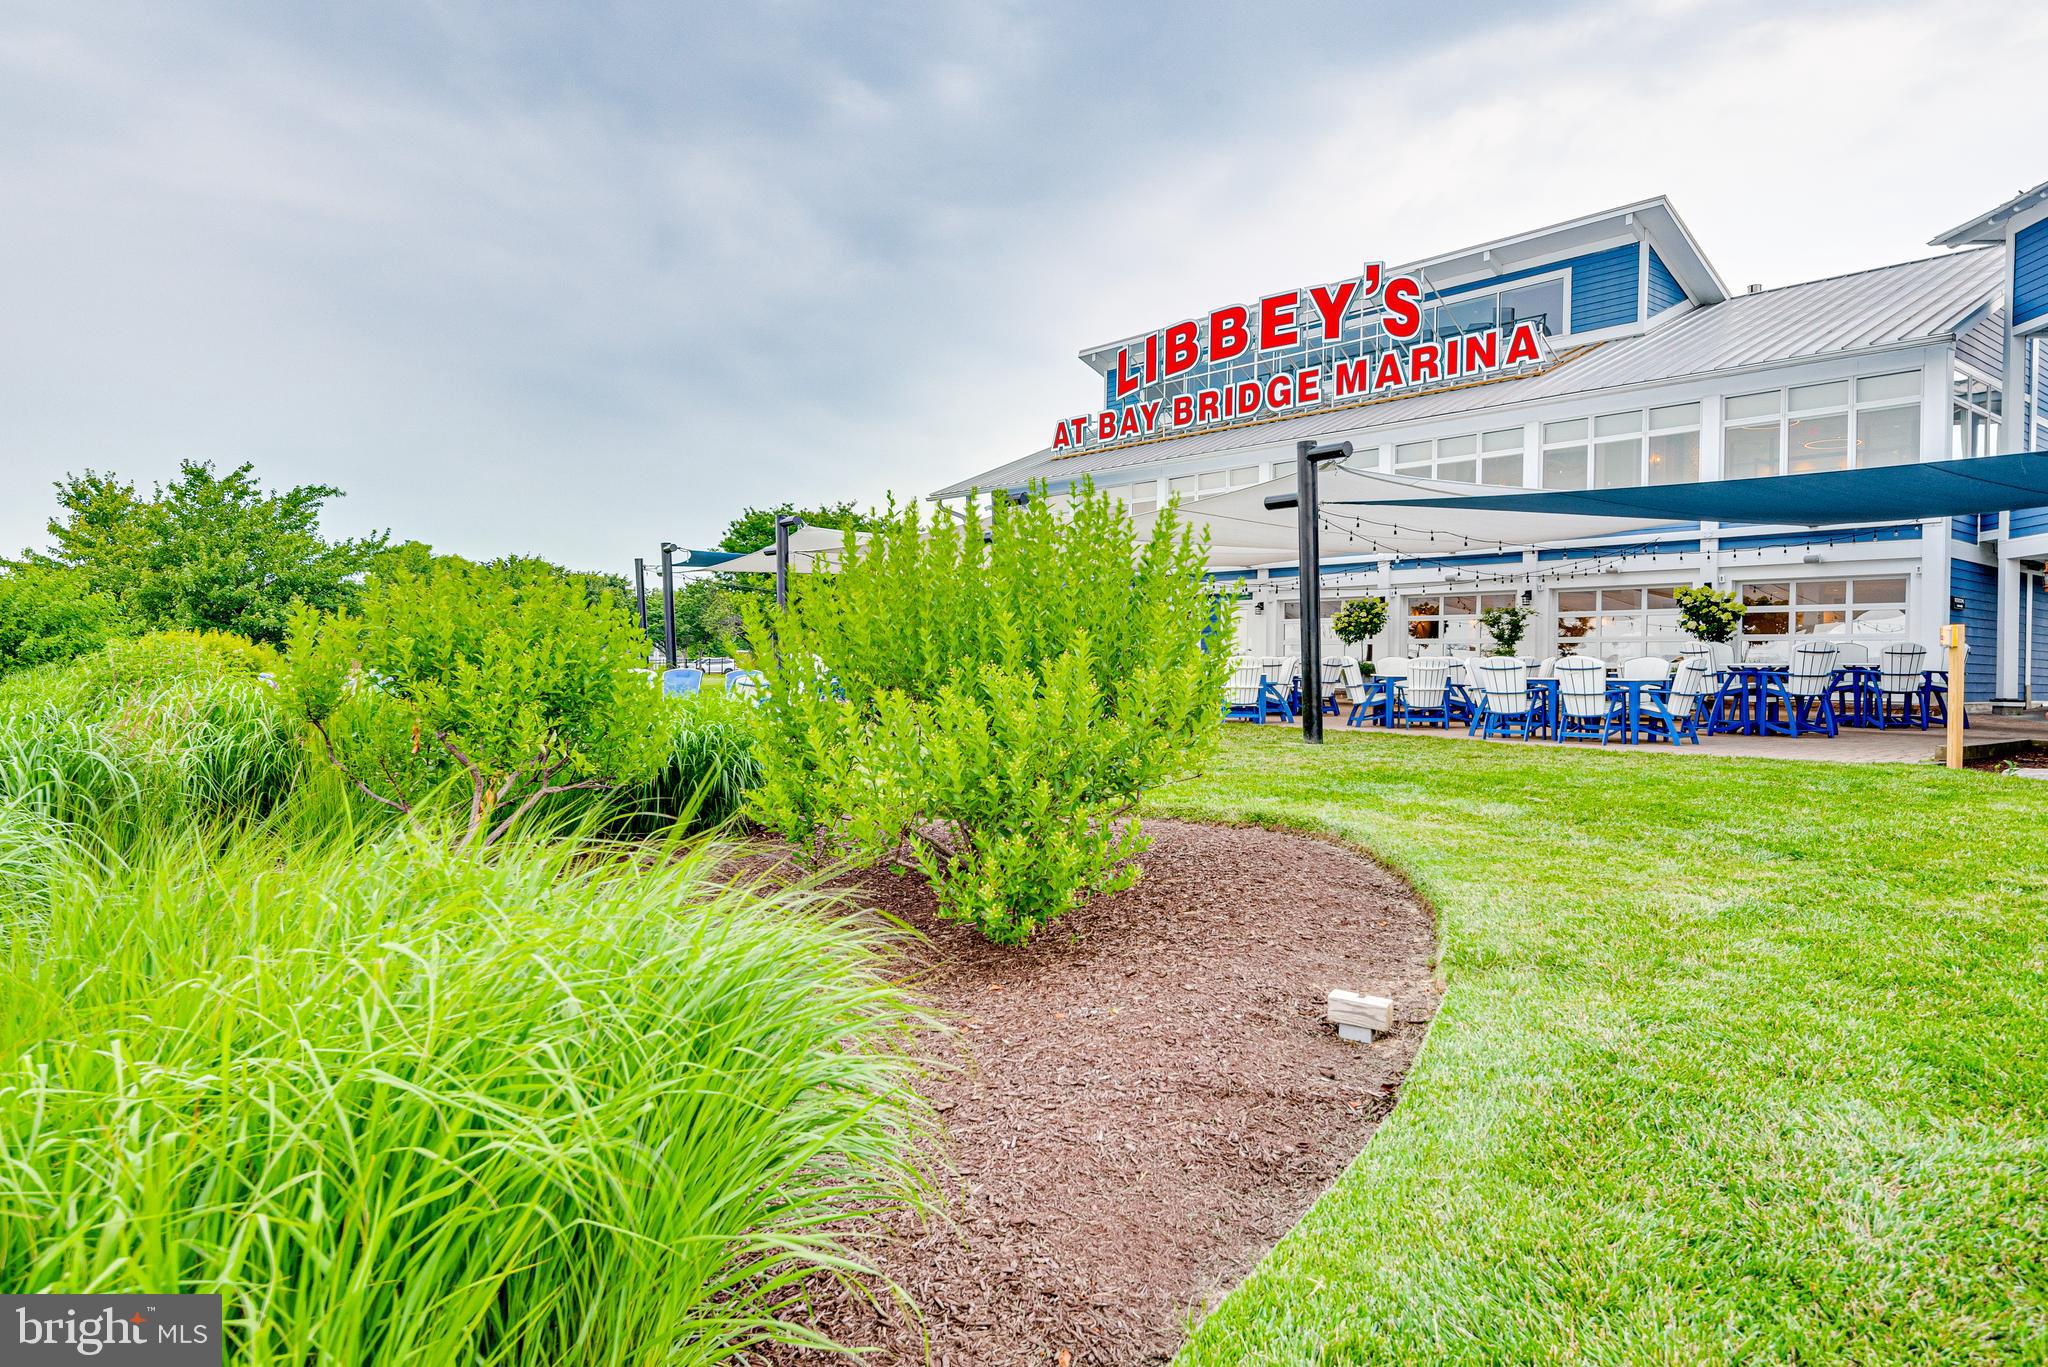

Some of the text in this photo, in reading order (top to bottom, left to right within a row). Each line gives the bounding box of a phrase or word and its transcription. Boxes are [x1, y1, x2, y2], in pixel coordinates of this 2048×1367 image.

[1052, 321, 1545, 451] AT BAY BRIDGE MARINA
[1115, 262, 1423, 400] LIBBEY'S
